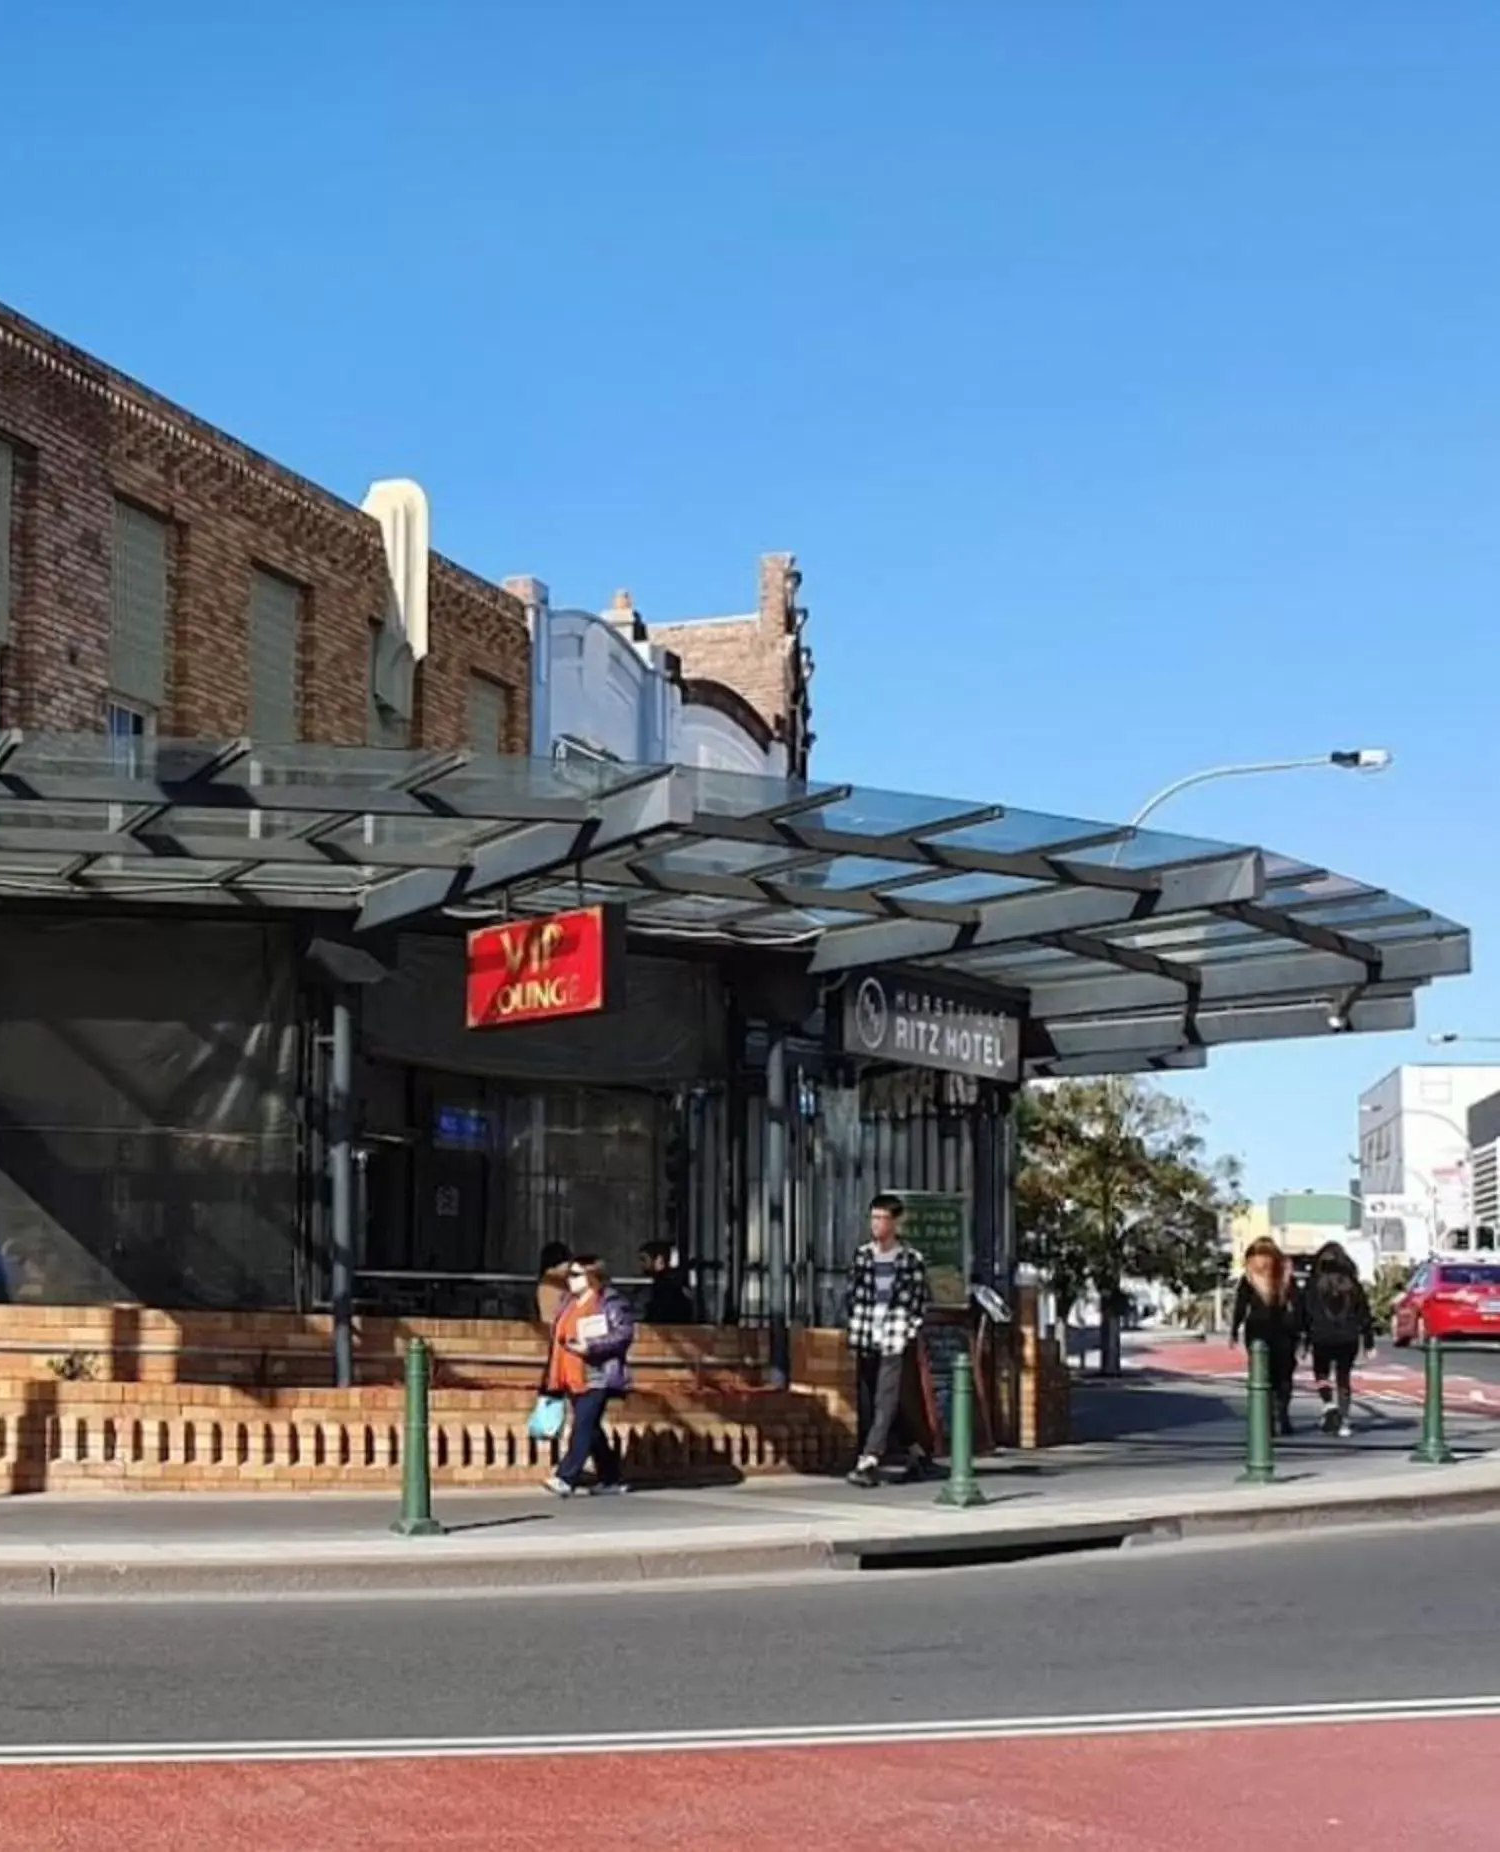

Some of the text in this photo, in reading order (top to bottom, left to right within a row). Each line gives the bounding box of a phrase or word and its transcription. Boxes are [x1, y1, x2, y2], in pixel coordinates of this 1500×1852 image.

[500, 923, 564, 974] VIP
[487, 972, 581, 1016] OUNGE
[895, 1015, 1005, 1069] RITZ HOTEL
